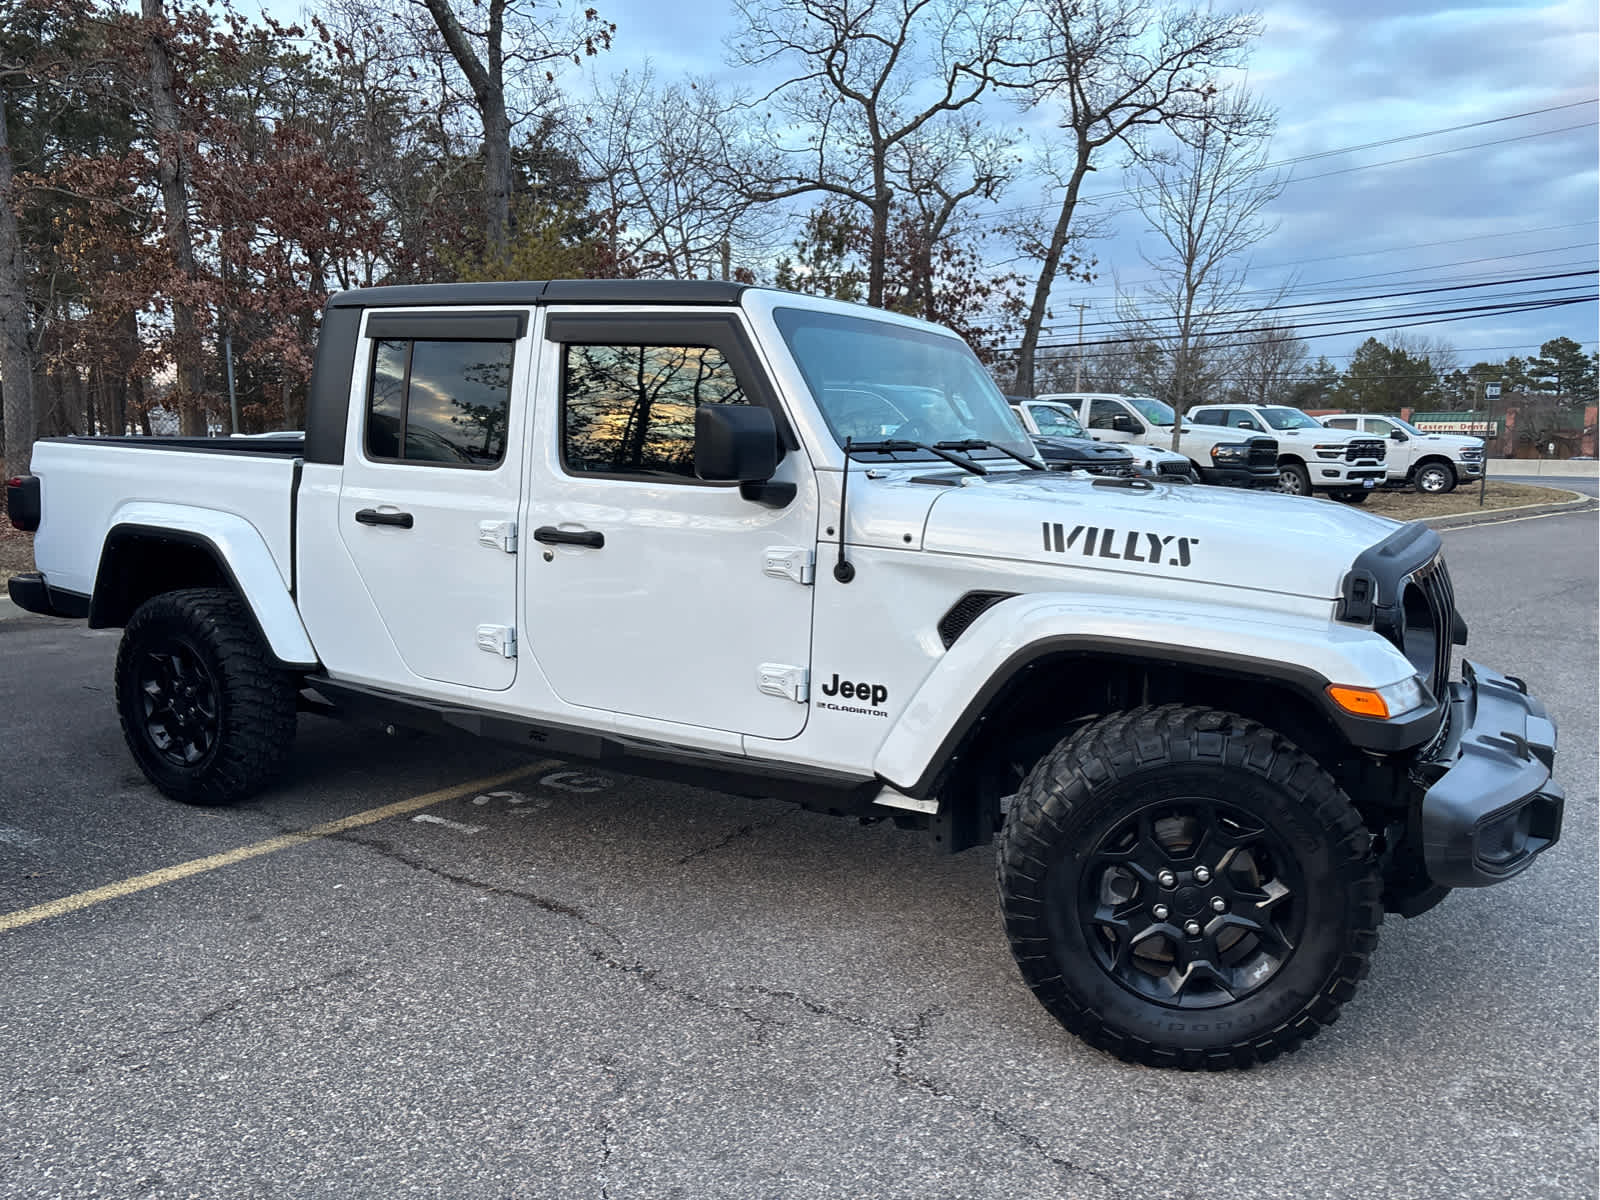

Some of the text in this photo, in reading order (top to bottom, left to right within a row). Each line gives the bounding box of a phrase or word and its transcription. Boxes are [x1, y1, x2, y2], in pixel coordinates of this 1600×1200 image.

[1042, 522, 1199, 567] WILLYS
[822, 673, 888, 707] Jeep
[827, 703, 888, 718] GLADIATOR
